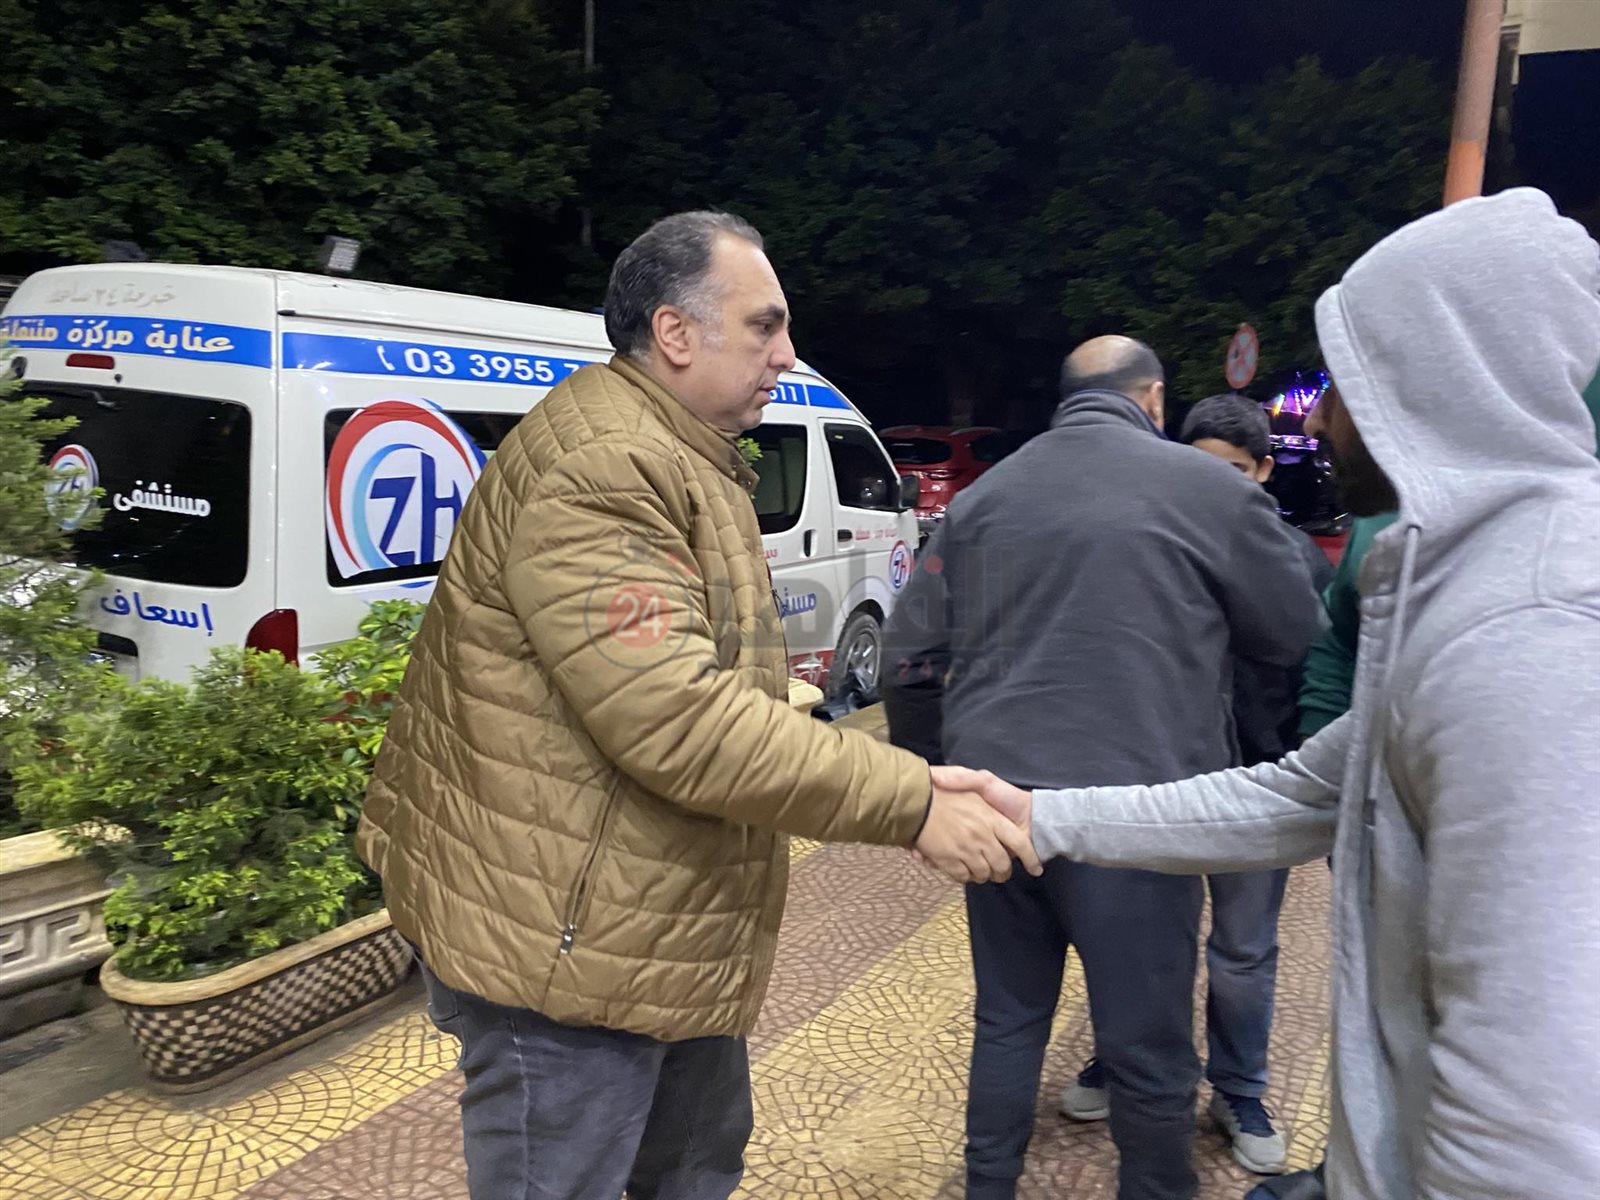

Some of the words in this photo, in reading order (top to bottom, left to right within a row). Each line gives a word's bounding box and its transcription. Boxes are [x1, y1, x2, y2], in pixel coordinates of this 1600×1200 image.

[66, 319, 134, 349] مركزة
[145, 323, 235, 354] عناية
[404, 347, 456, 375] 03
[469, 353, 555, 383] 3955
[113, 480, 211, 517] مستشفى
[101, 588, 214, 636] إسعاف
